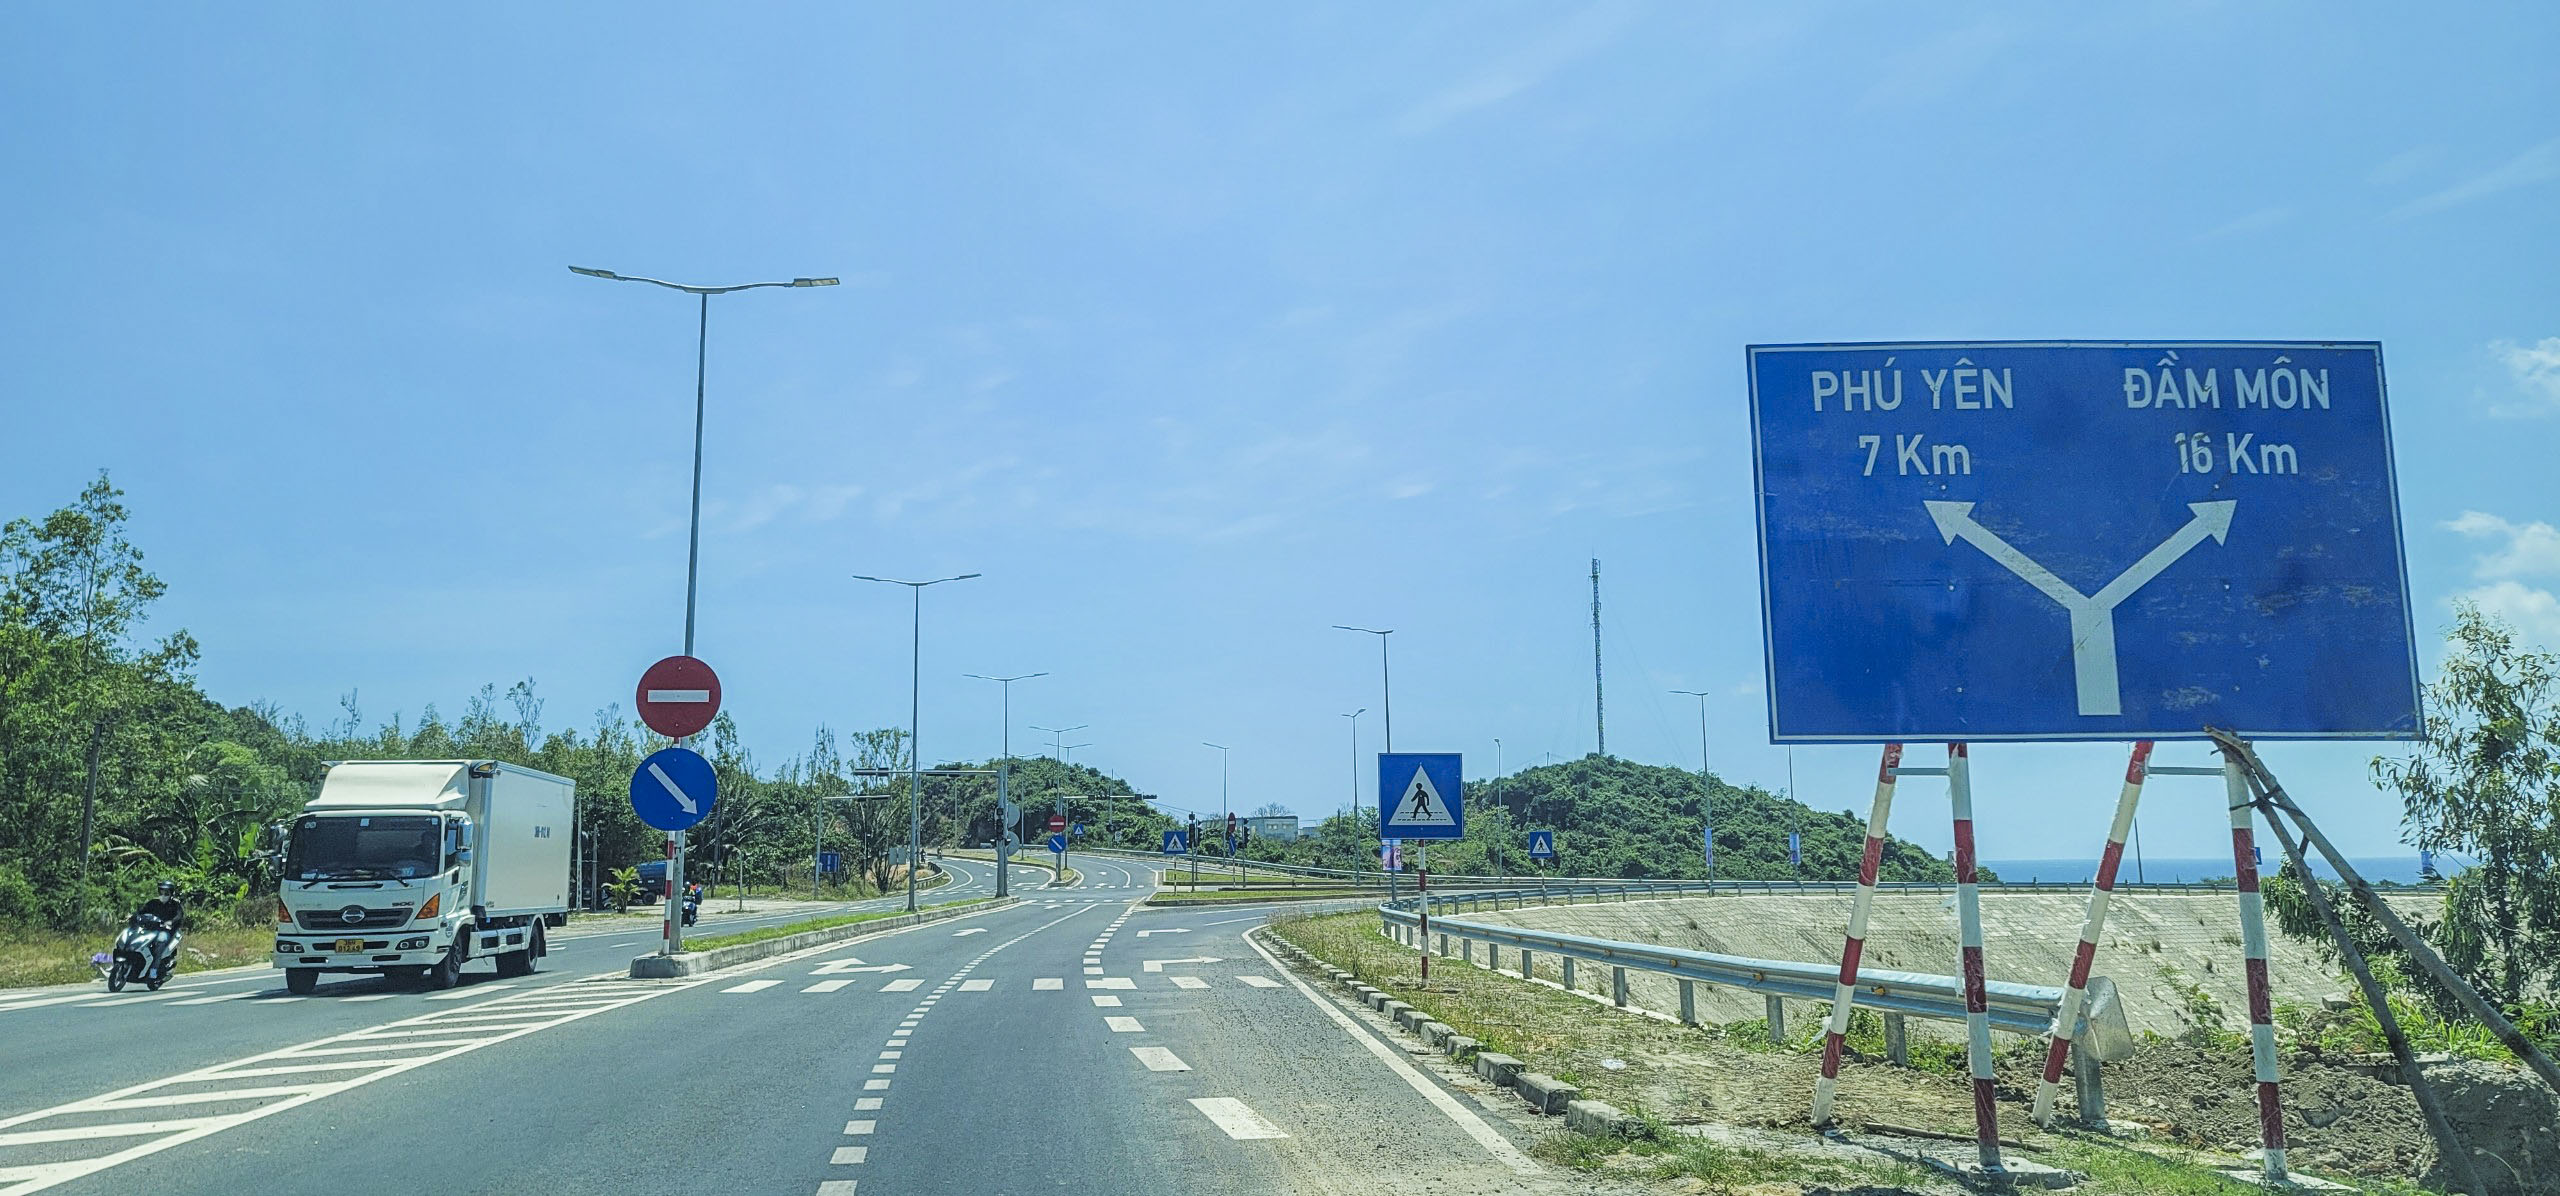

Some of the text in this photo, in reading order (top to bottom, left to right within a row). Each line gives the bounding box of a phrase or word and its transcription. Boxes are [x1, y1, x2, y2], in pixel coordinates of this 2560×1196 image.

[1812, 357, 2014, 412] PHÚ YÊN
[2123, 350, 2330, 410] ĐẦM MÔN
[1858, 434, 1972, 476] 7 Km
[2174, 432, 2298, 475] 16 Km
